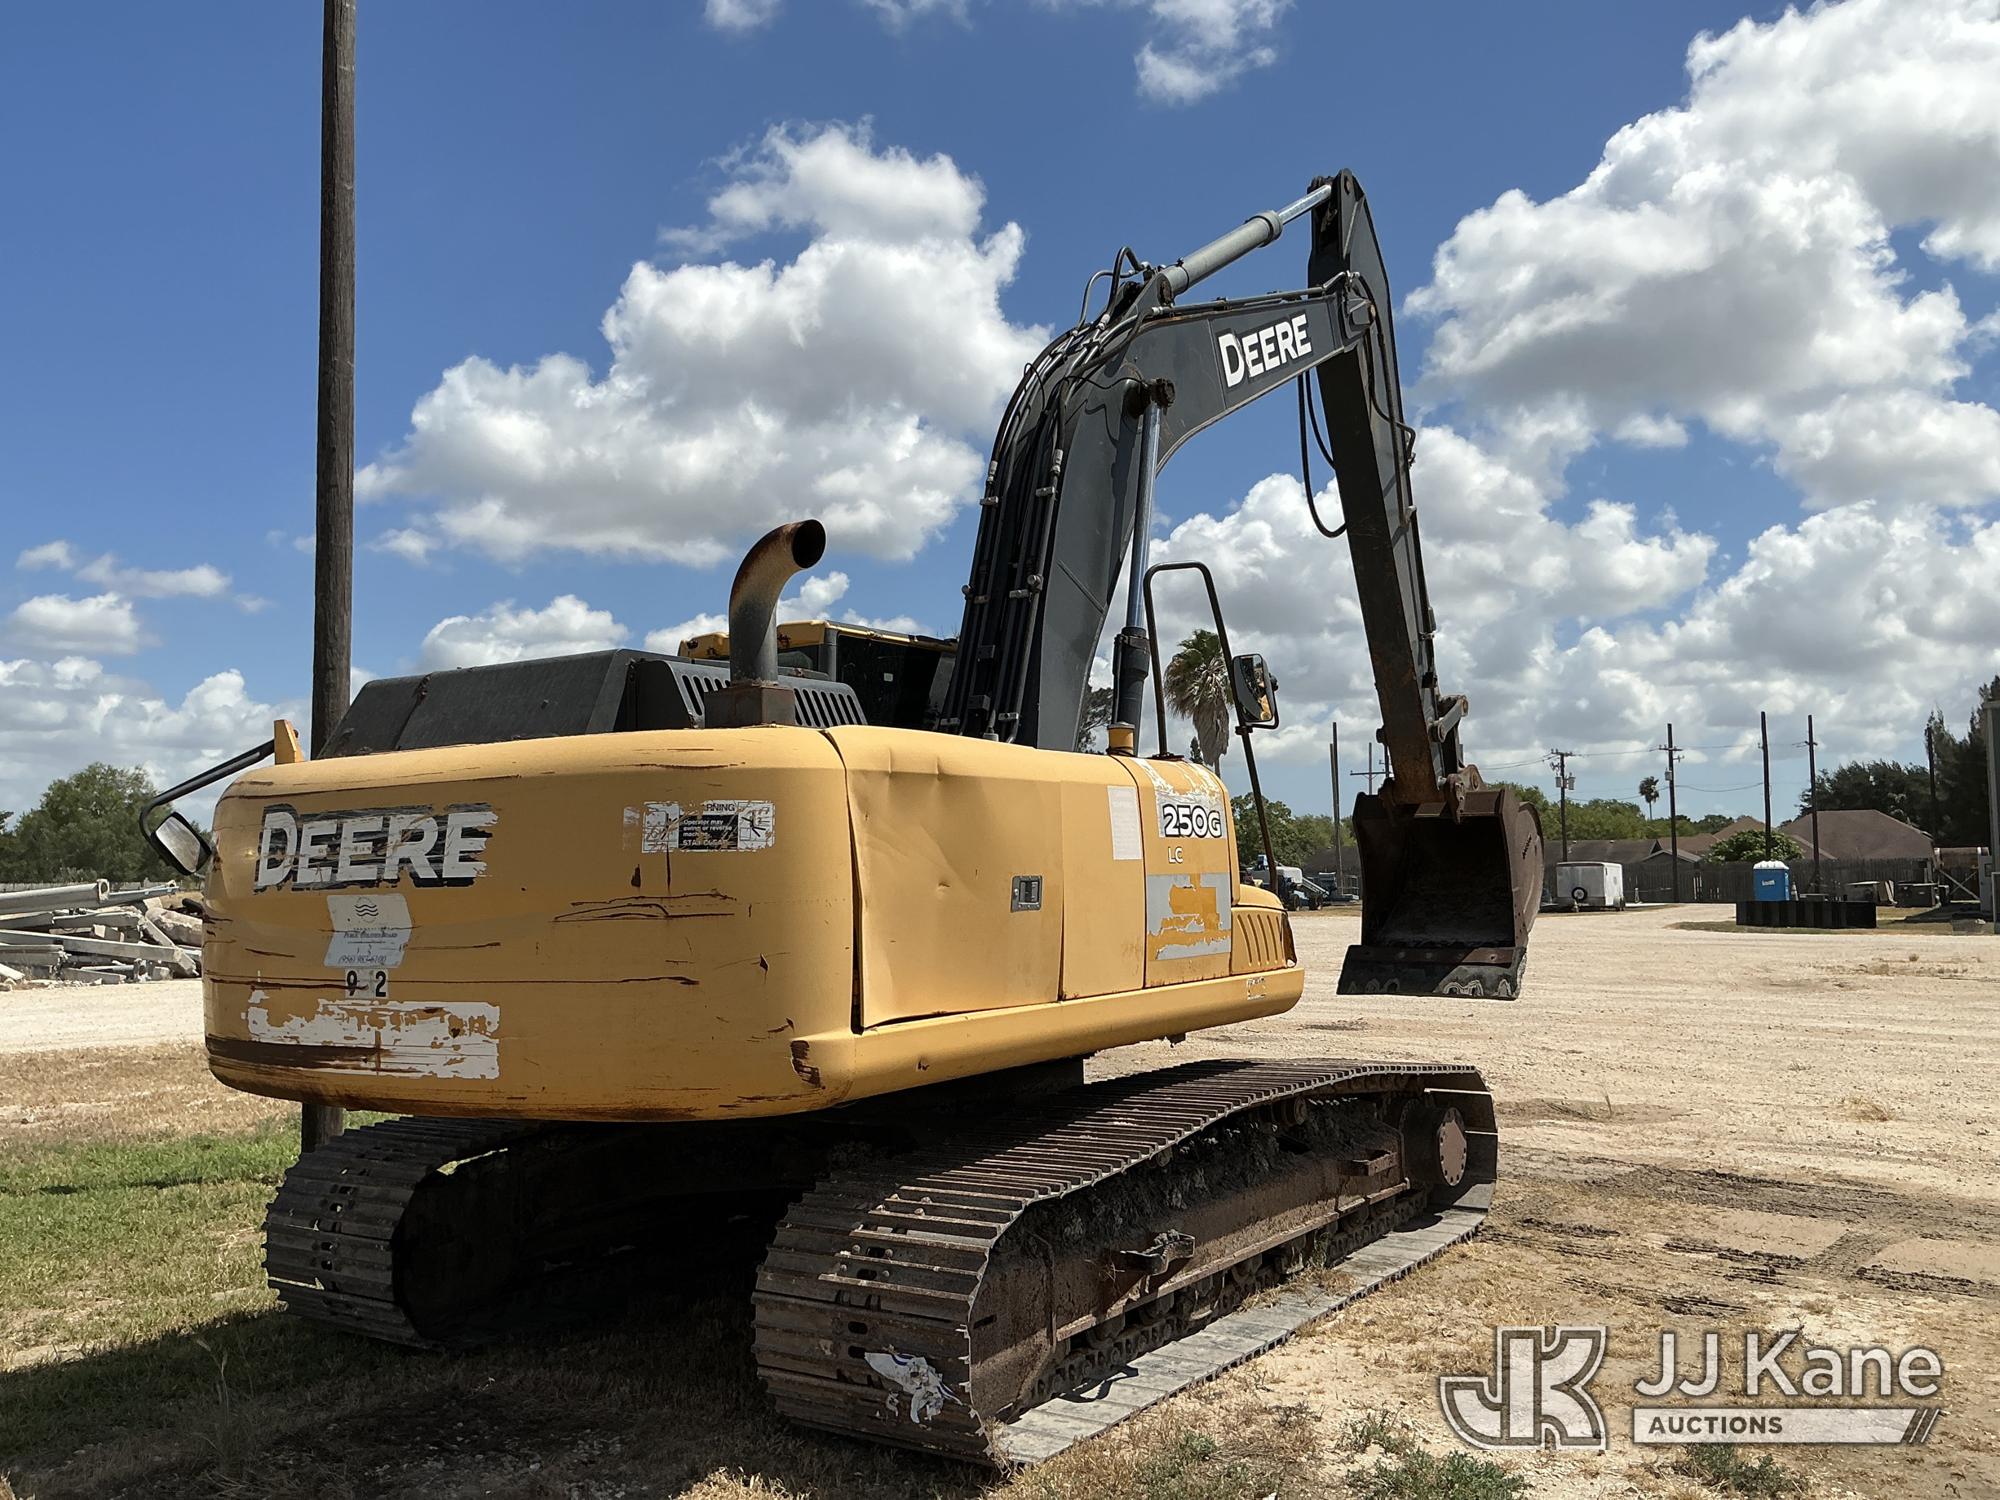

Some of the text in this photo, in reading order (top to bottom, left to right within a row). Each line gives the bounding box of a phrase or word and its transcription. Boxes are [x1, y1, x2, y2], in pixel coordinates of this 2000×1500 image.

[1218, 313, 1312, 388] DEERE
[1162, 803, 1222, 838] 250G
[256, 809, 498, 888] DEERE
[1167, 846, 1184, 864] LC
